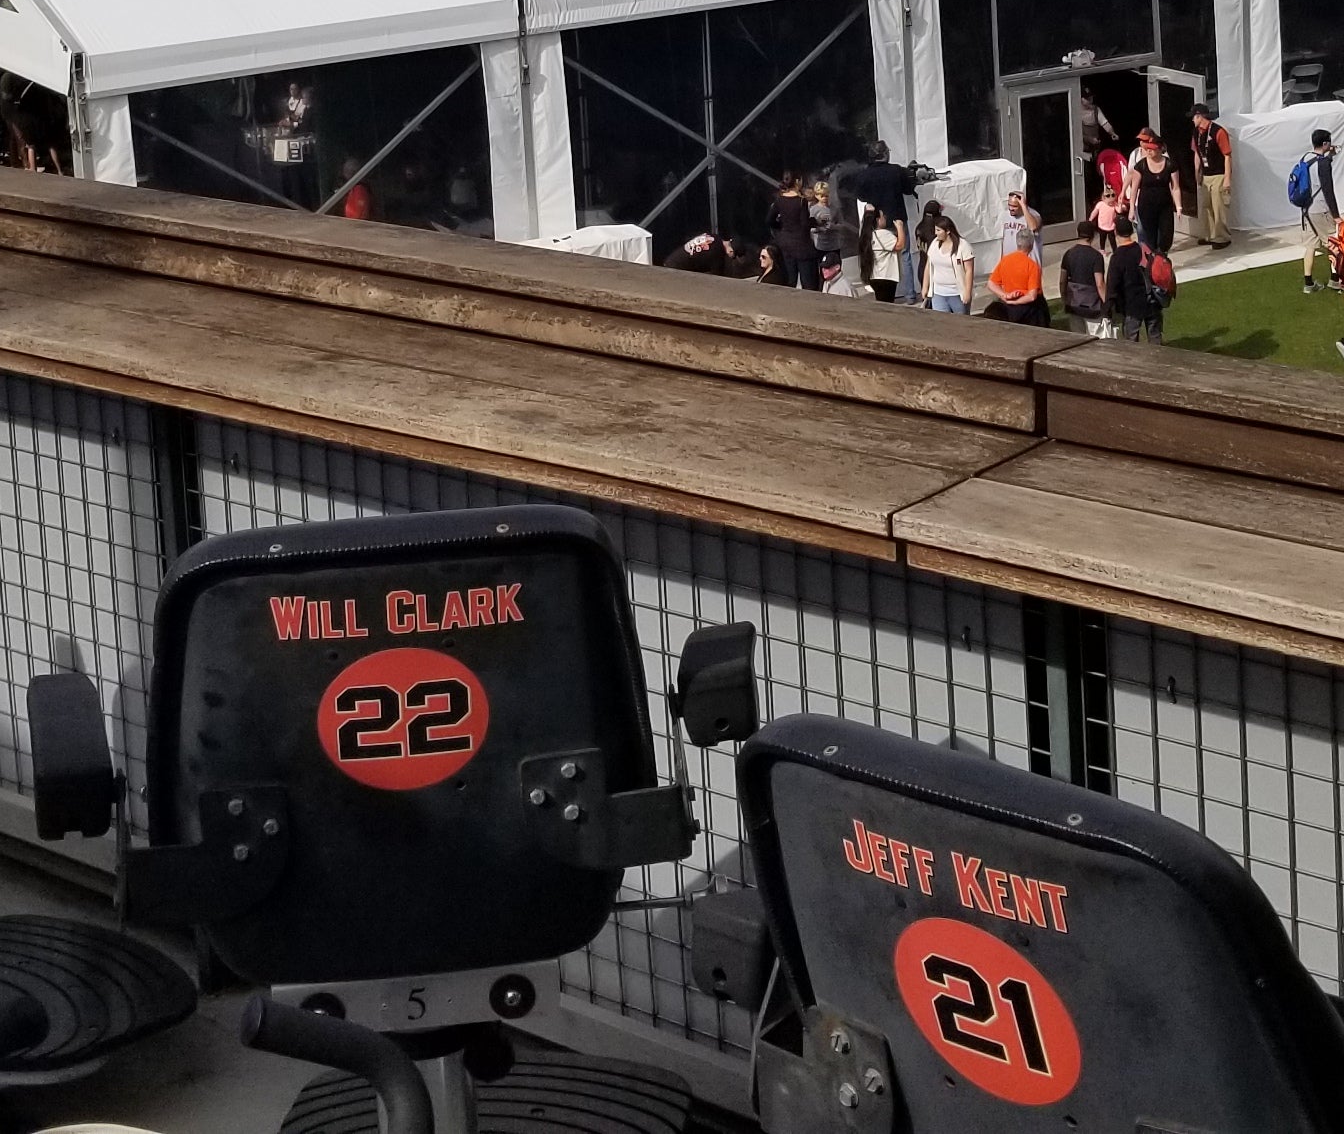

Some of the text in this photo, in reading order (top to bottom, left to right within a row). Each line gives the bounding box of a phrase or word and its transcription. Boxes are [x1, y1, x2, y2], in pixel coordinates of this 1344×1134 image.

[270, 583, 524, 641] WILL CLARK
[335, 677, 473, 762] 22
[843, 819, 1068, 933] JEFF KENT
[408, 987, 426, 1020] 5
[921, 953, 1053, 1078] 21
